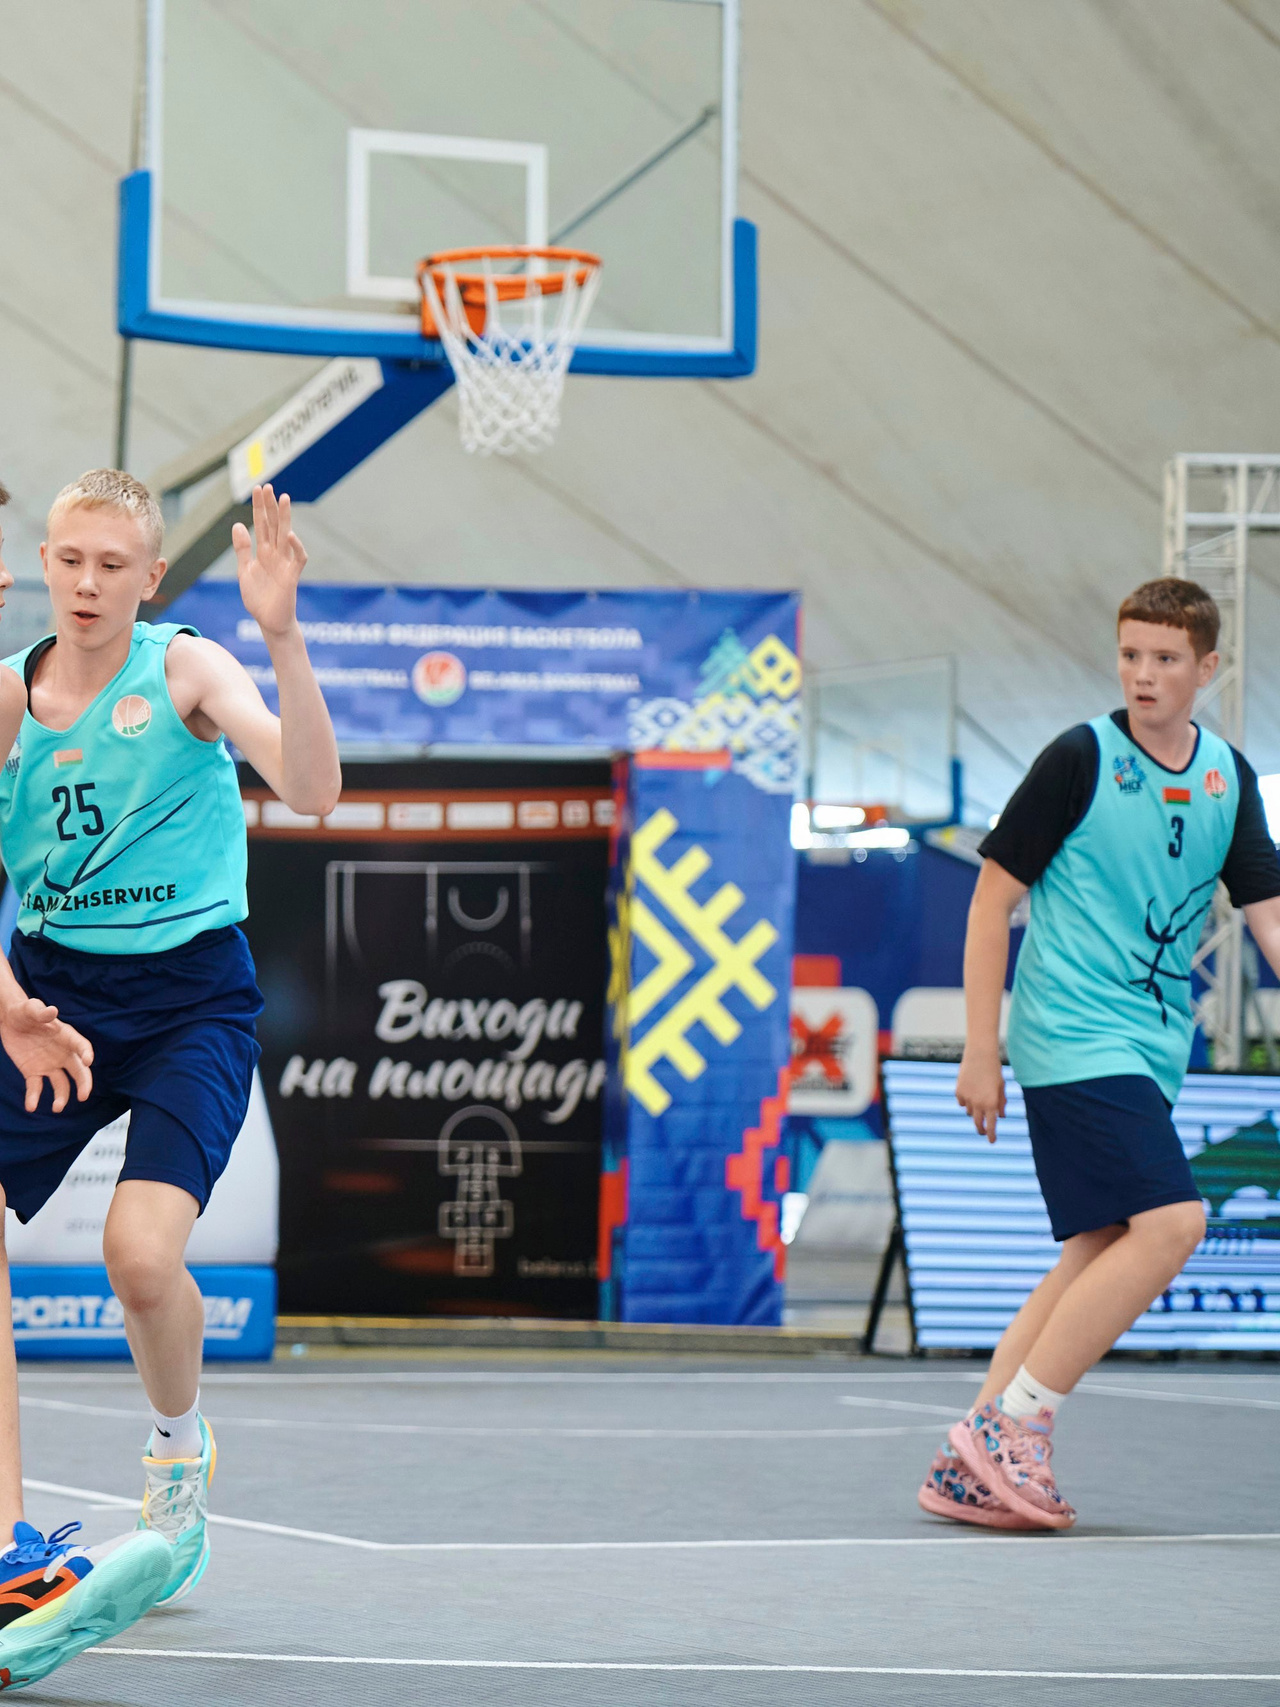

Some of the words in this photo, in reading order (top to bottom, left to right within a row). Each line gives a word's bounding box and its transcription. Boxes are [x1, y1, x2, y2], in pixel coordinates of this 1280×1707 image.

[51, 782, 105, 841] 25
[1168, 815, 1184, 858] 3
[279, 1055, 358, 1099] на
